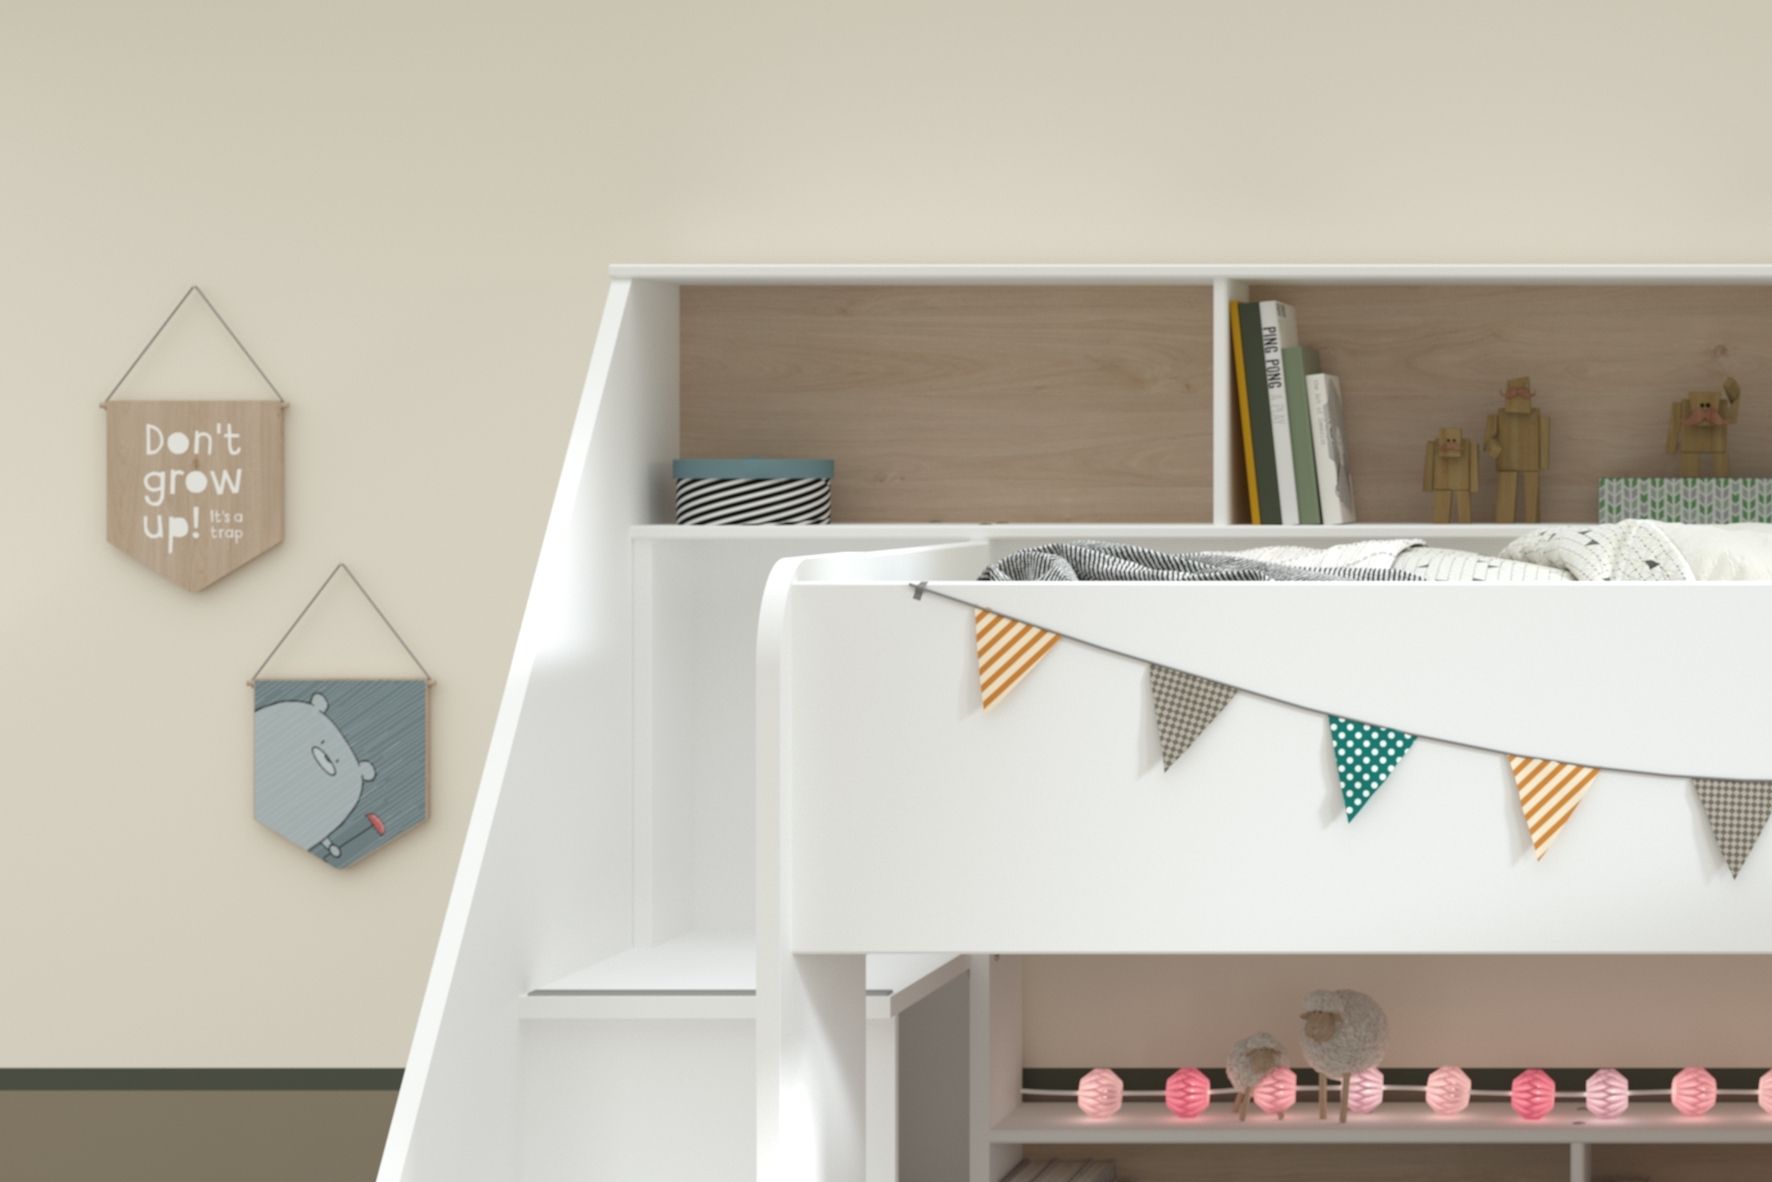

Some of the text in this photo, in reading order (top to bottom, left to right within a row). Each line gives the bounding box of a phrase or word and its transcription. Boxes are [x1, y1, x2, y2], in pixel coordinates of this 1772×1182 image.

[1262, 326, 1279, 353] PING
[1265, 358, 1282, 389] PONG
[145, 422, 241, 456] Don't
[143, 468, 243, 507] grow
[143, 505, 200, 555] up!
[209, 509, 244, 524] It's a
[210, 526, 244, 544] trap
